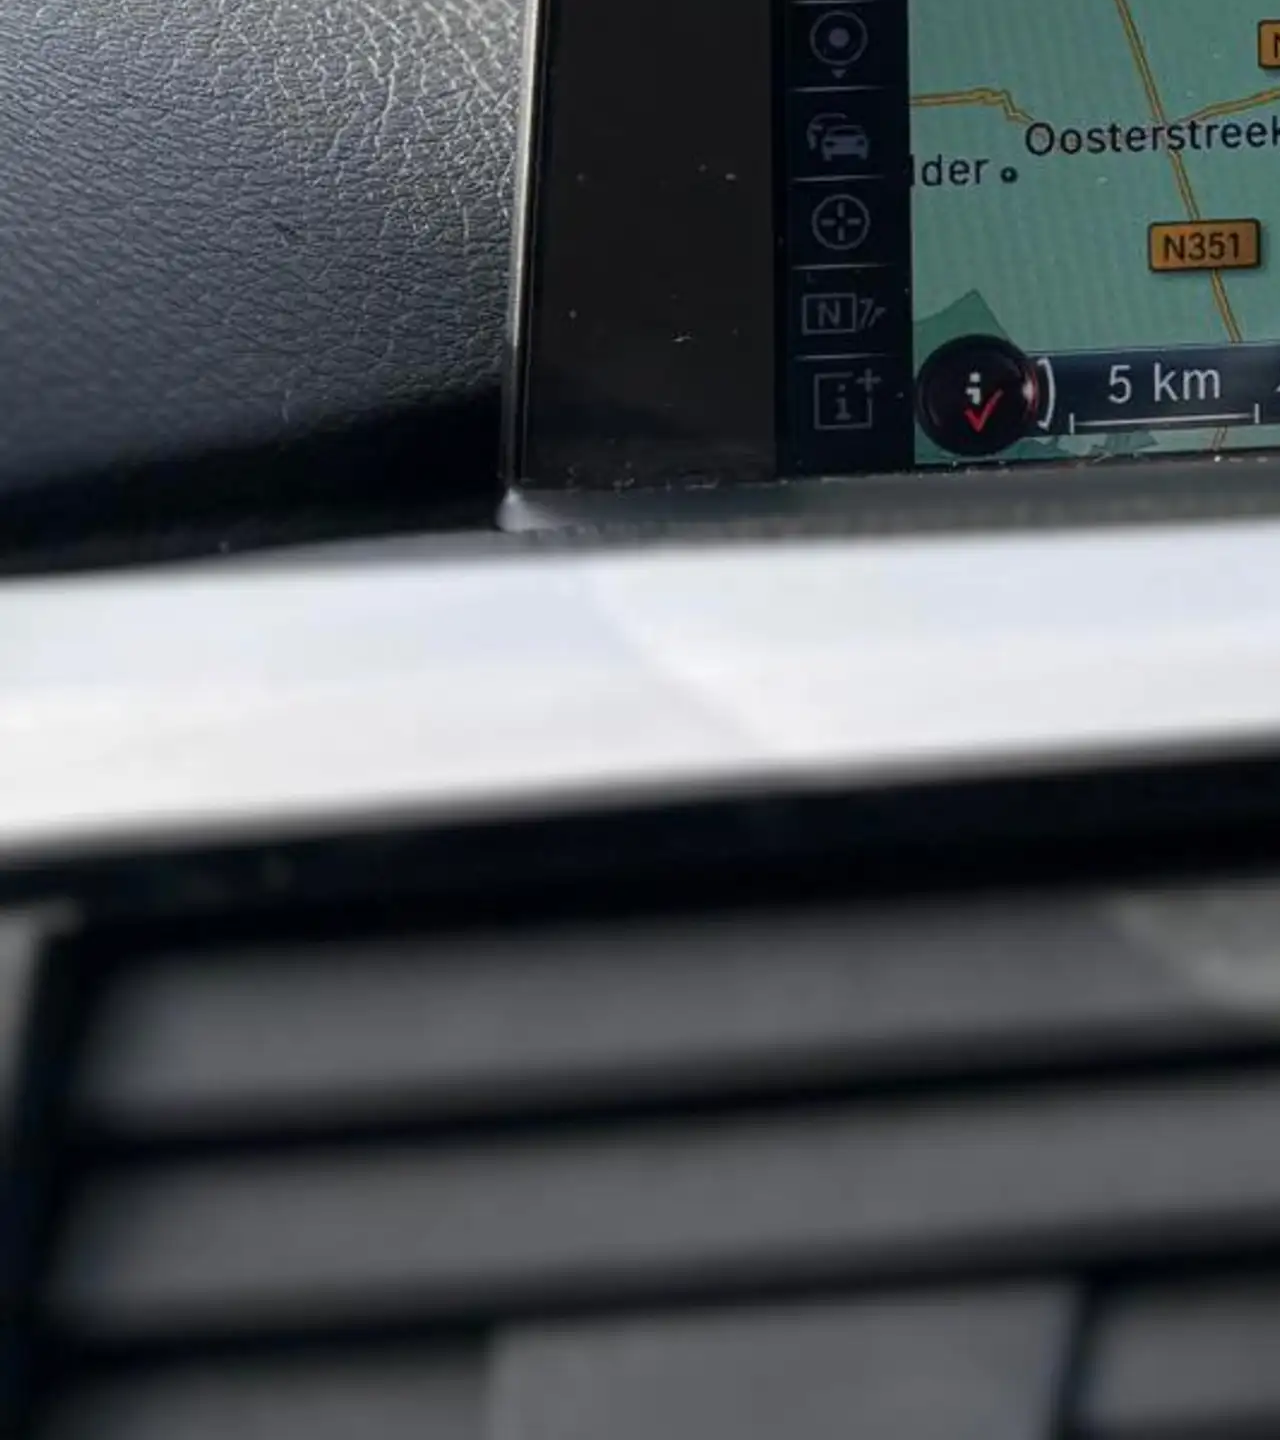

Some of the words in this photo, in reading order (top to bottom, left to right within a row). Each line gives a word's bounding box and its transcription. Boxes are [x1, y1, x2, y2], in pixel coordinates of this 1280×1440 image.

[1163, 232, 1241, 262] N351
[1108, 365, 1132, 403] 5
[1154, 362, 1221, 402] km
